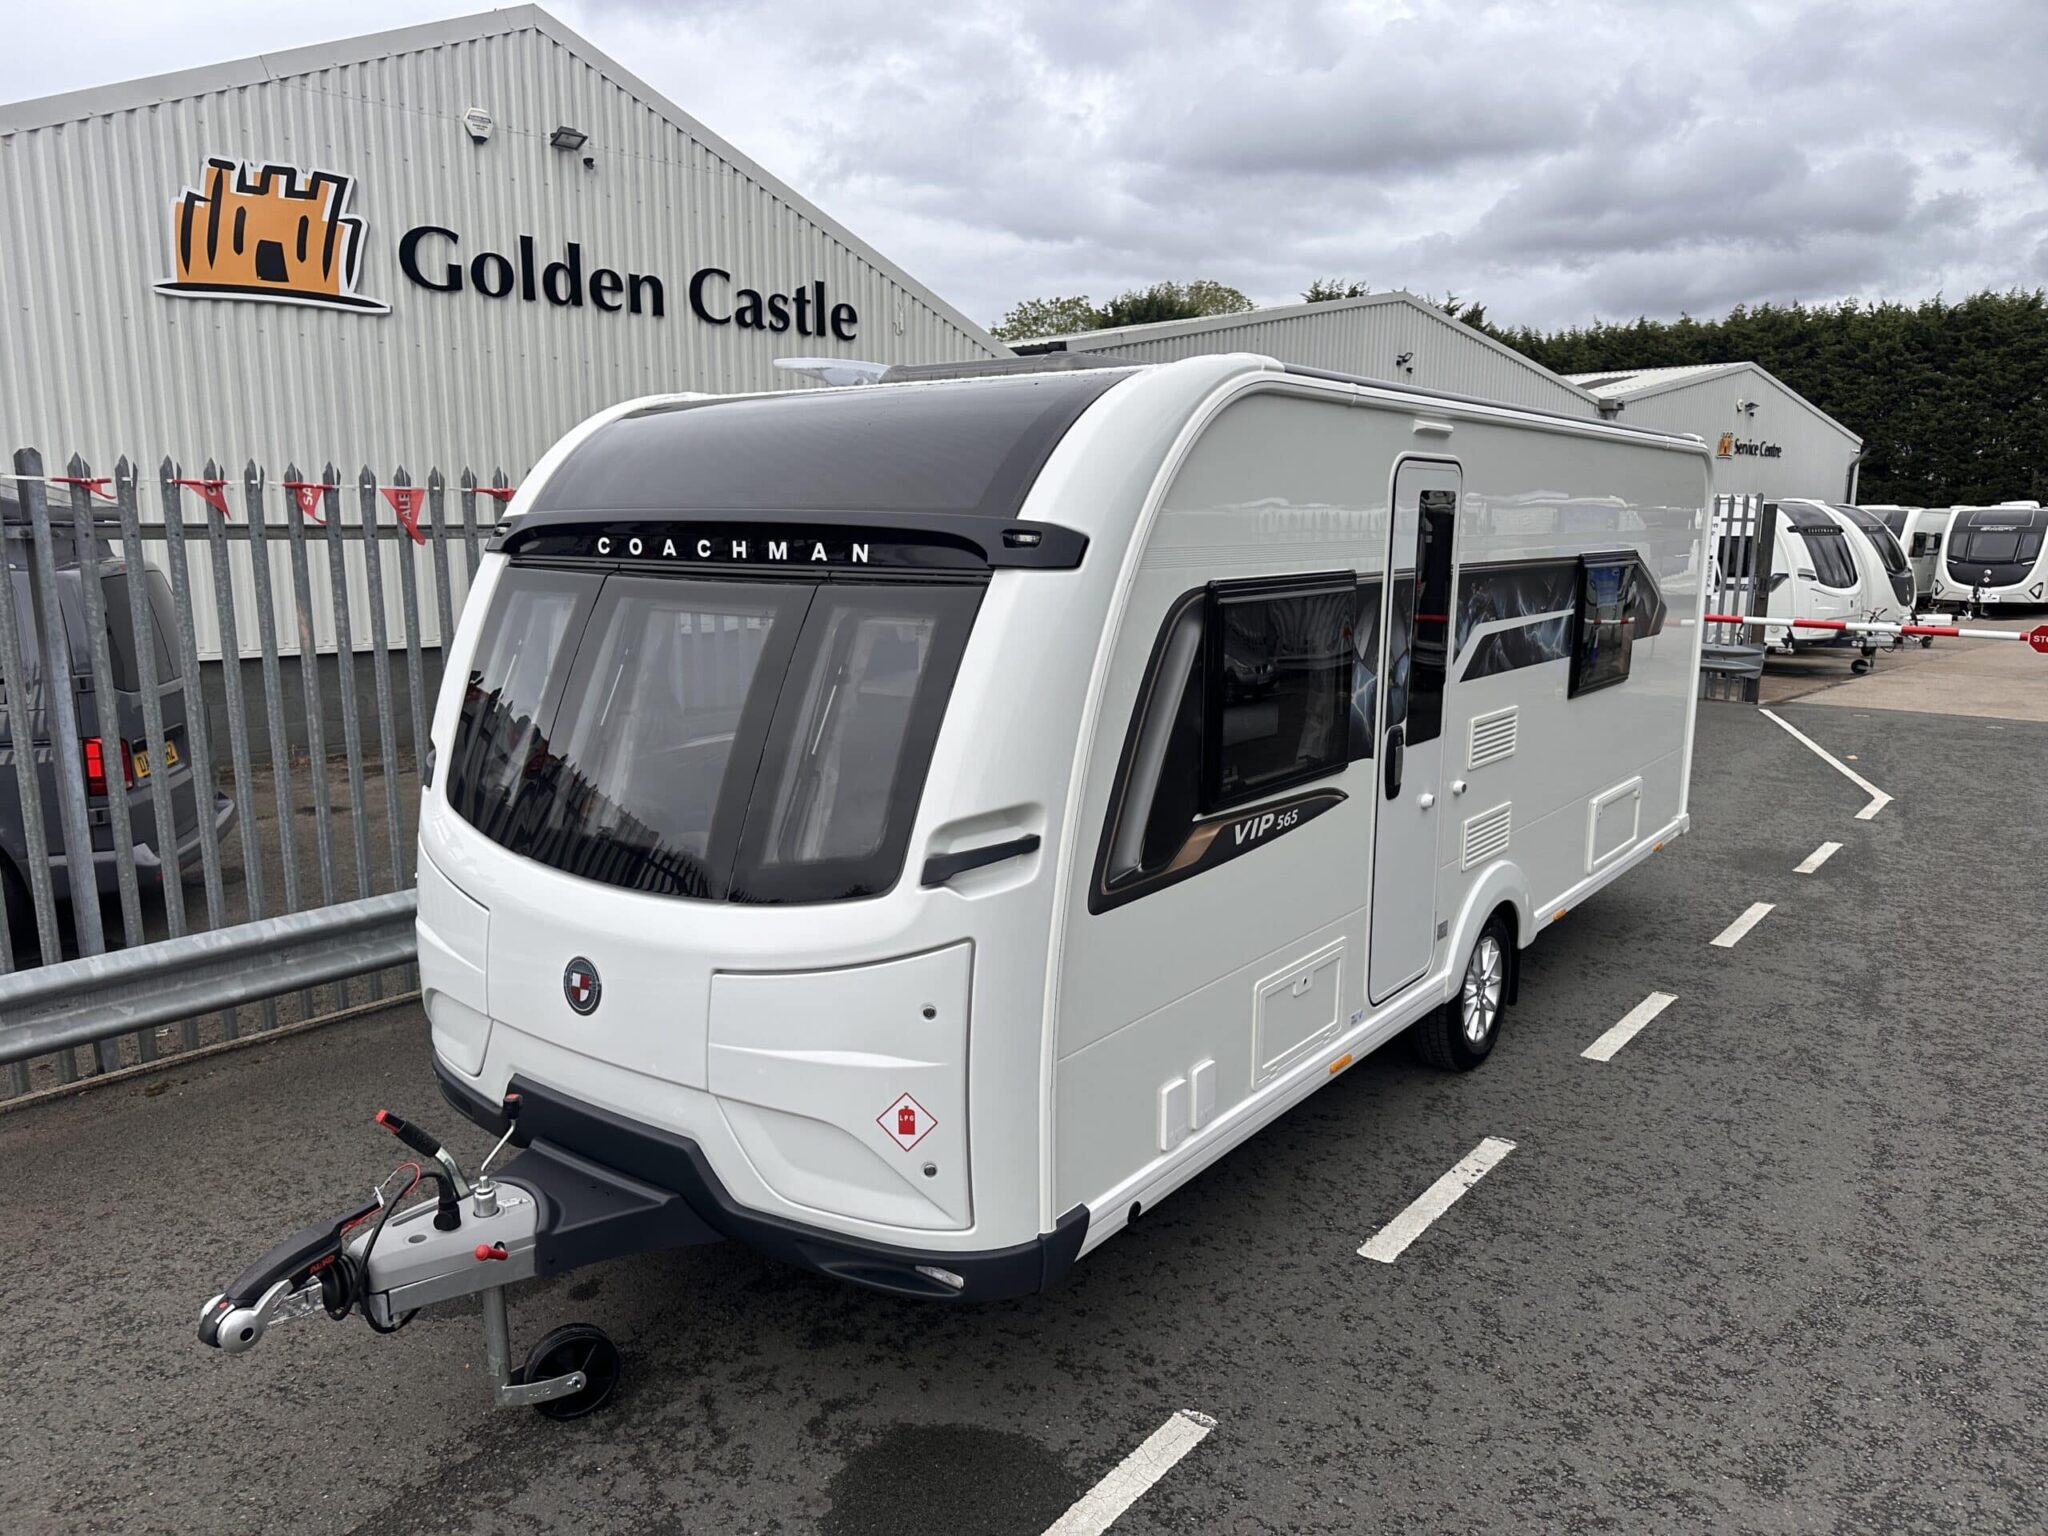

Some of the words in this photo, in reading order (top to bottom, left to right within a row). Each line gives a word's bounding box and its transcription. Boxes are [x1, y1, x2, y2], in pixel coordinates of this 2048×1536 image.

[399, 225, 664, 317] Golden
[689, 267, 858, 341] Castle
[1734, 438, 1759, 456] Service
[1760, 441, 1782, 458] Centre
[597, 537, 869, 563] COACHMAN
[1235, 813, 1275, 845] VIP
[1276, 809, 1299, 830] 565
